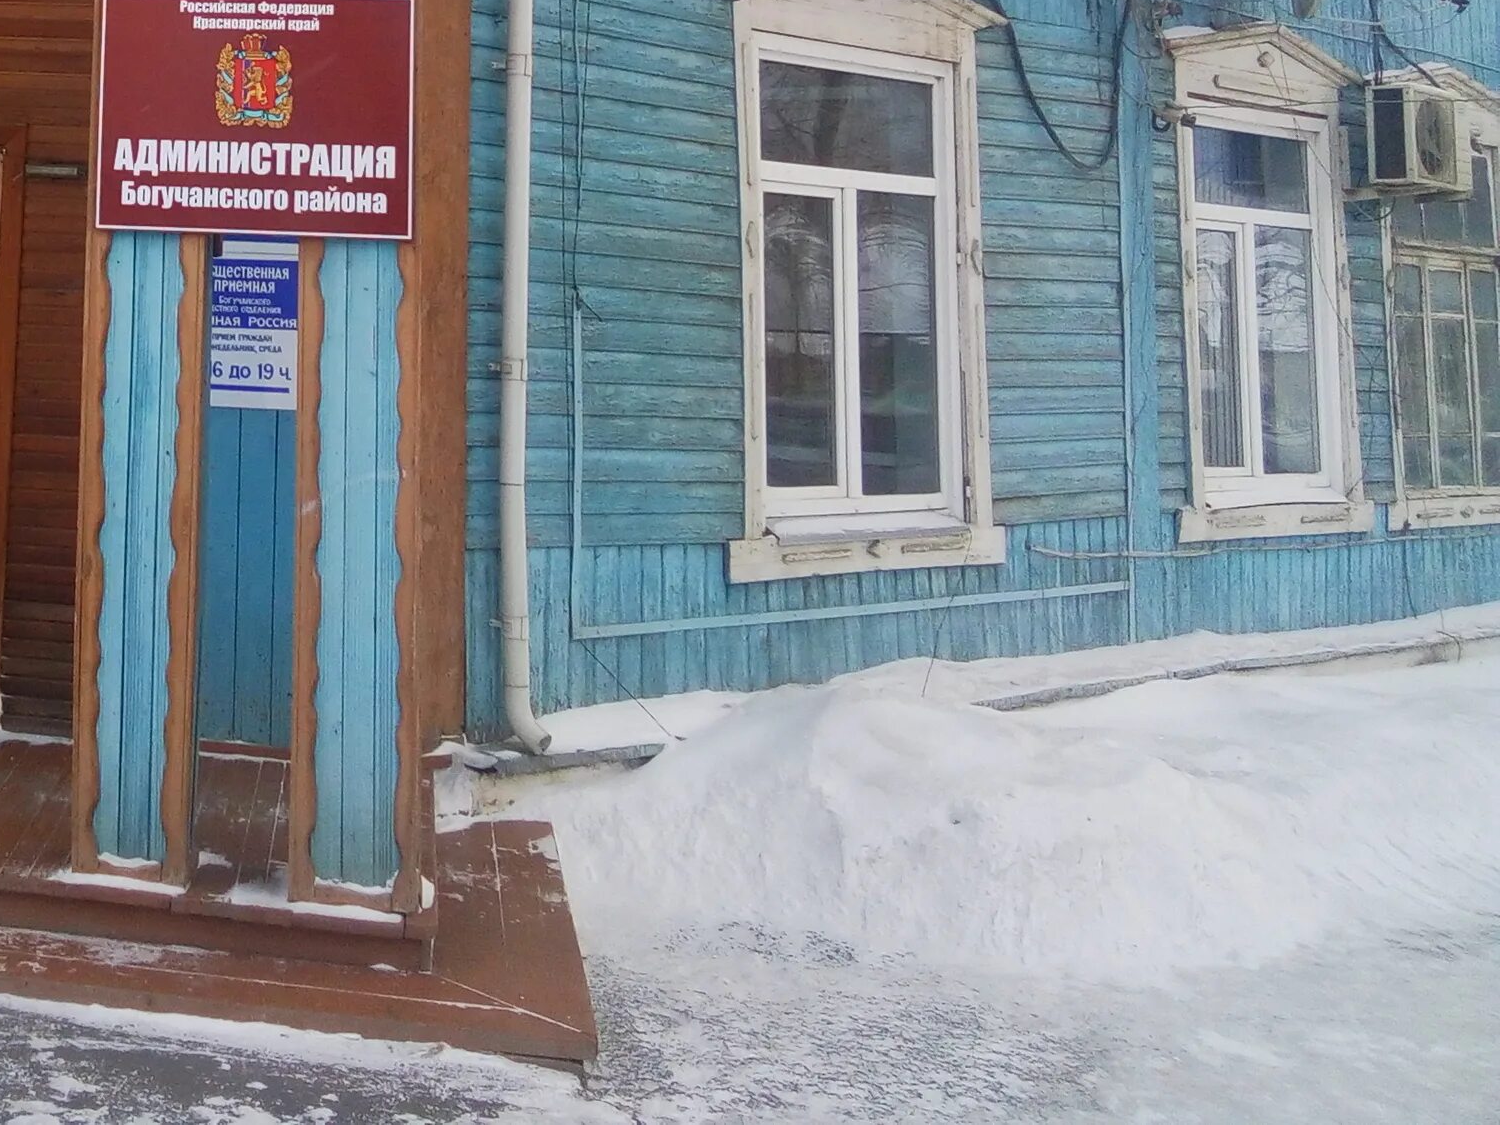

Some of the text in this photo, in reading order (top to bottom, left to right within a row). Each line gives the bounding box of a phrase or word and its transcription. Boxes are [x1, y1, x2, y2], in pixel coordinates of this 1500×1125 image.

[179, 0, 335, 16] Российская Федерация
[193, 15, 320, 32] Красноярский край
[113, 138, 396, 183] АДМИНИСТРАЦИЯ
[120, 180, 388, 214] Богучанского района
[211, 315, 298, 329] НАЯ РОССИЯ
[257, 362, 275, 381] 19
